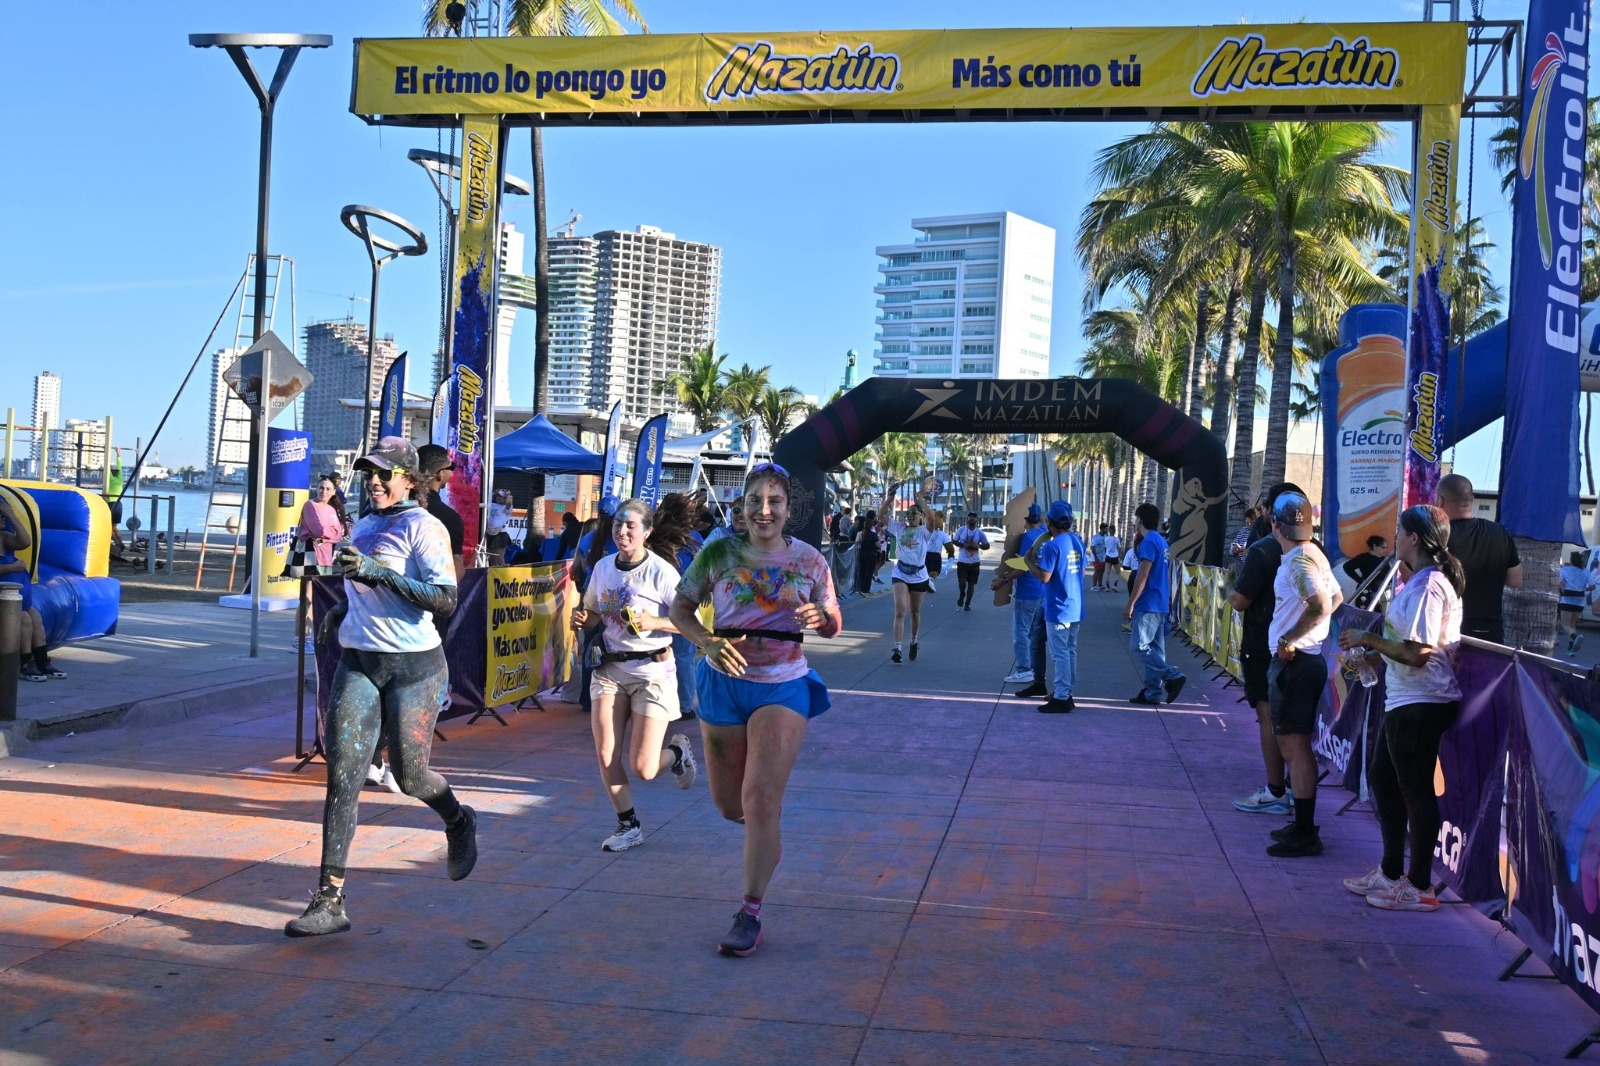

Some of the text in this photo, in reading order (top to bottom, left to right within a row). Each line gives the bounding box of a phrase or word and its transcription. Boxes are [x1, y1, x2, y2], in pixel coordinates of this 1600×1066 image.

[395, 63, 666, 100] El ritmo lo pongo yo
[704, 41, 901, 103] Mazatún
[953, 55, 1141, 88] Más como tú
[1191, 33, 1398, 97] Mazatún
[468, 132, 493, 221] Mazatún
[1423, 140, 1452, 232] Mazatún
[1545, 11, 1586, 353] Electrolit
[975, 380, 1102, 401] IMDEM
[457, 364, 484, 456] Mazatún
[973, 401, 1100, 421] MAZATLÁN
[1410, 372, 1439, 463] Mazatún
[1342, 430, 1403, 447] Electro
[493, 578, 519, 599] Donde
[492, 607, 506, 631] yo
[493, 634, 511, 658] Más
[530, 628, 537, 651] tú
